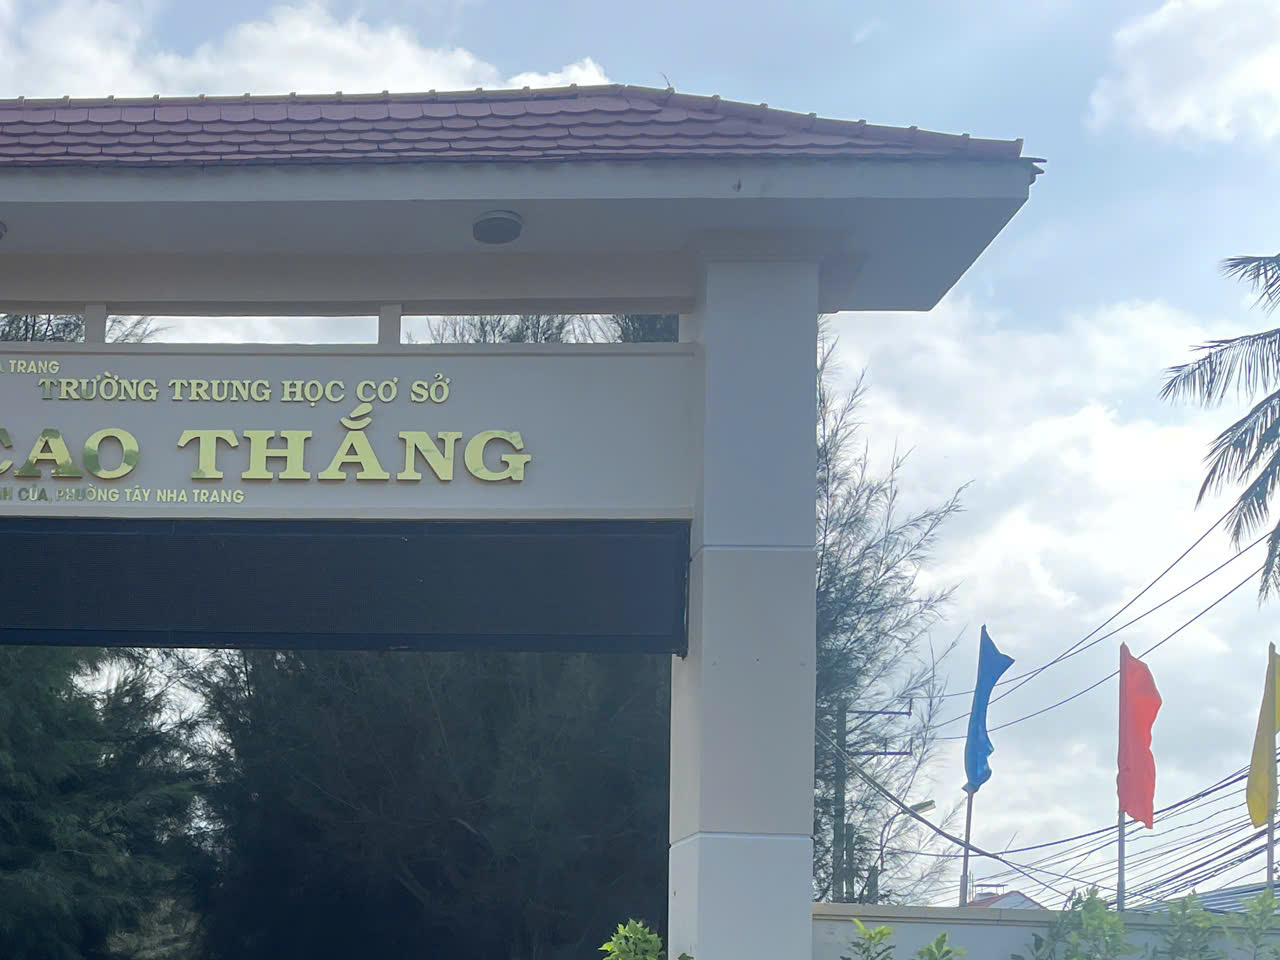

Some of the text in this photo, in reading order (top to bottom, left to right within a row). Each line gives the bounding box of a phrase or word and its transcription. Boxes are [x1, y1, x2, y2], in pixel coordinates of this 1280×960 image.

[9, 359, 60, 374] TRANG
[38, 371, 451, 407] TRƯỜNG TRUNG HỌC CƠ SỞ
[177, 402, 532, 482] THẮNG
[56, 484, 120, 502] PHƯỜNG
[125, 485, 151, 501] TÂY
[157, 488, 188, 502] NHA
[192, 489, 245, 503] TRANG
